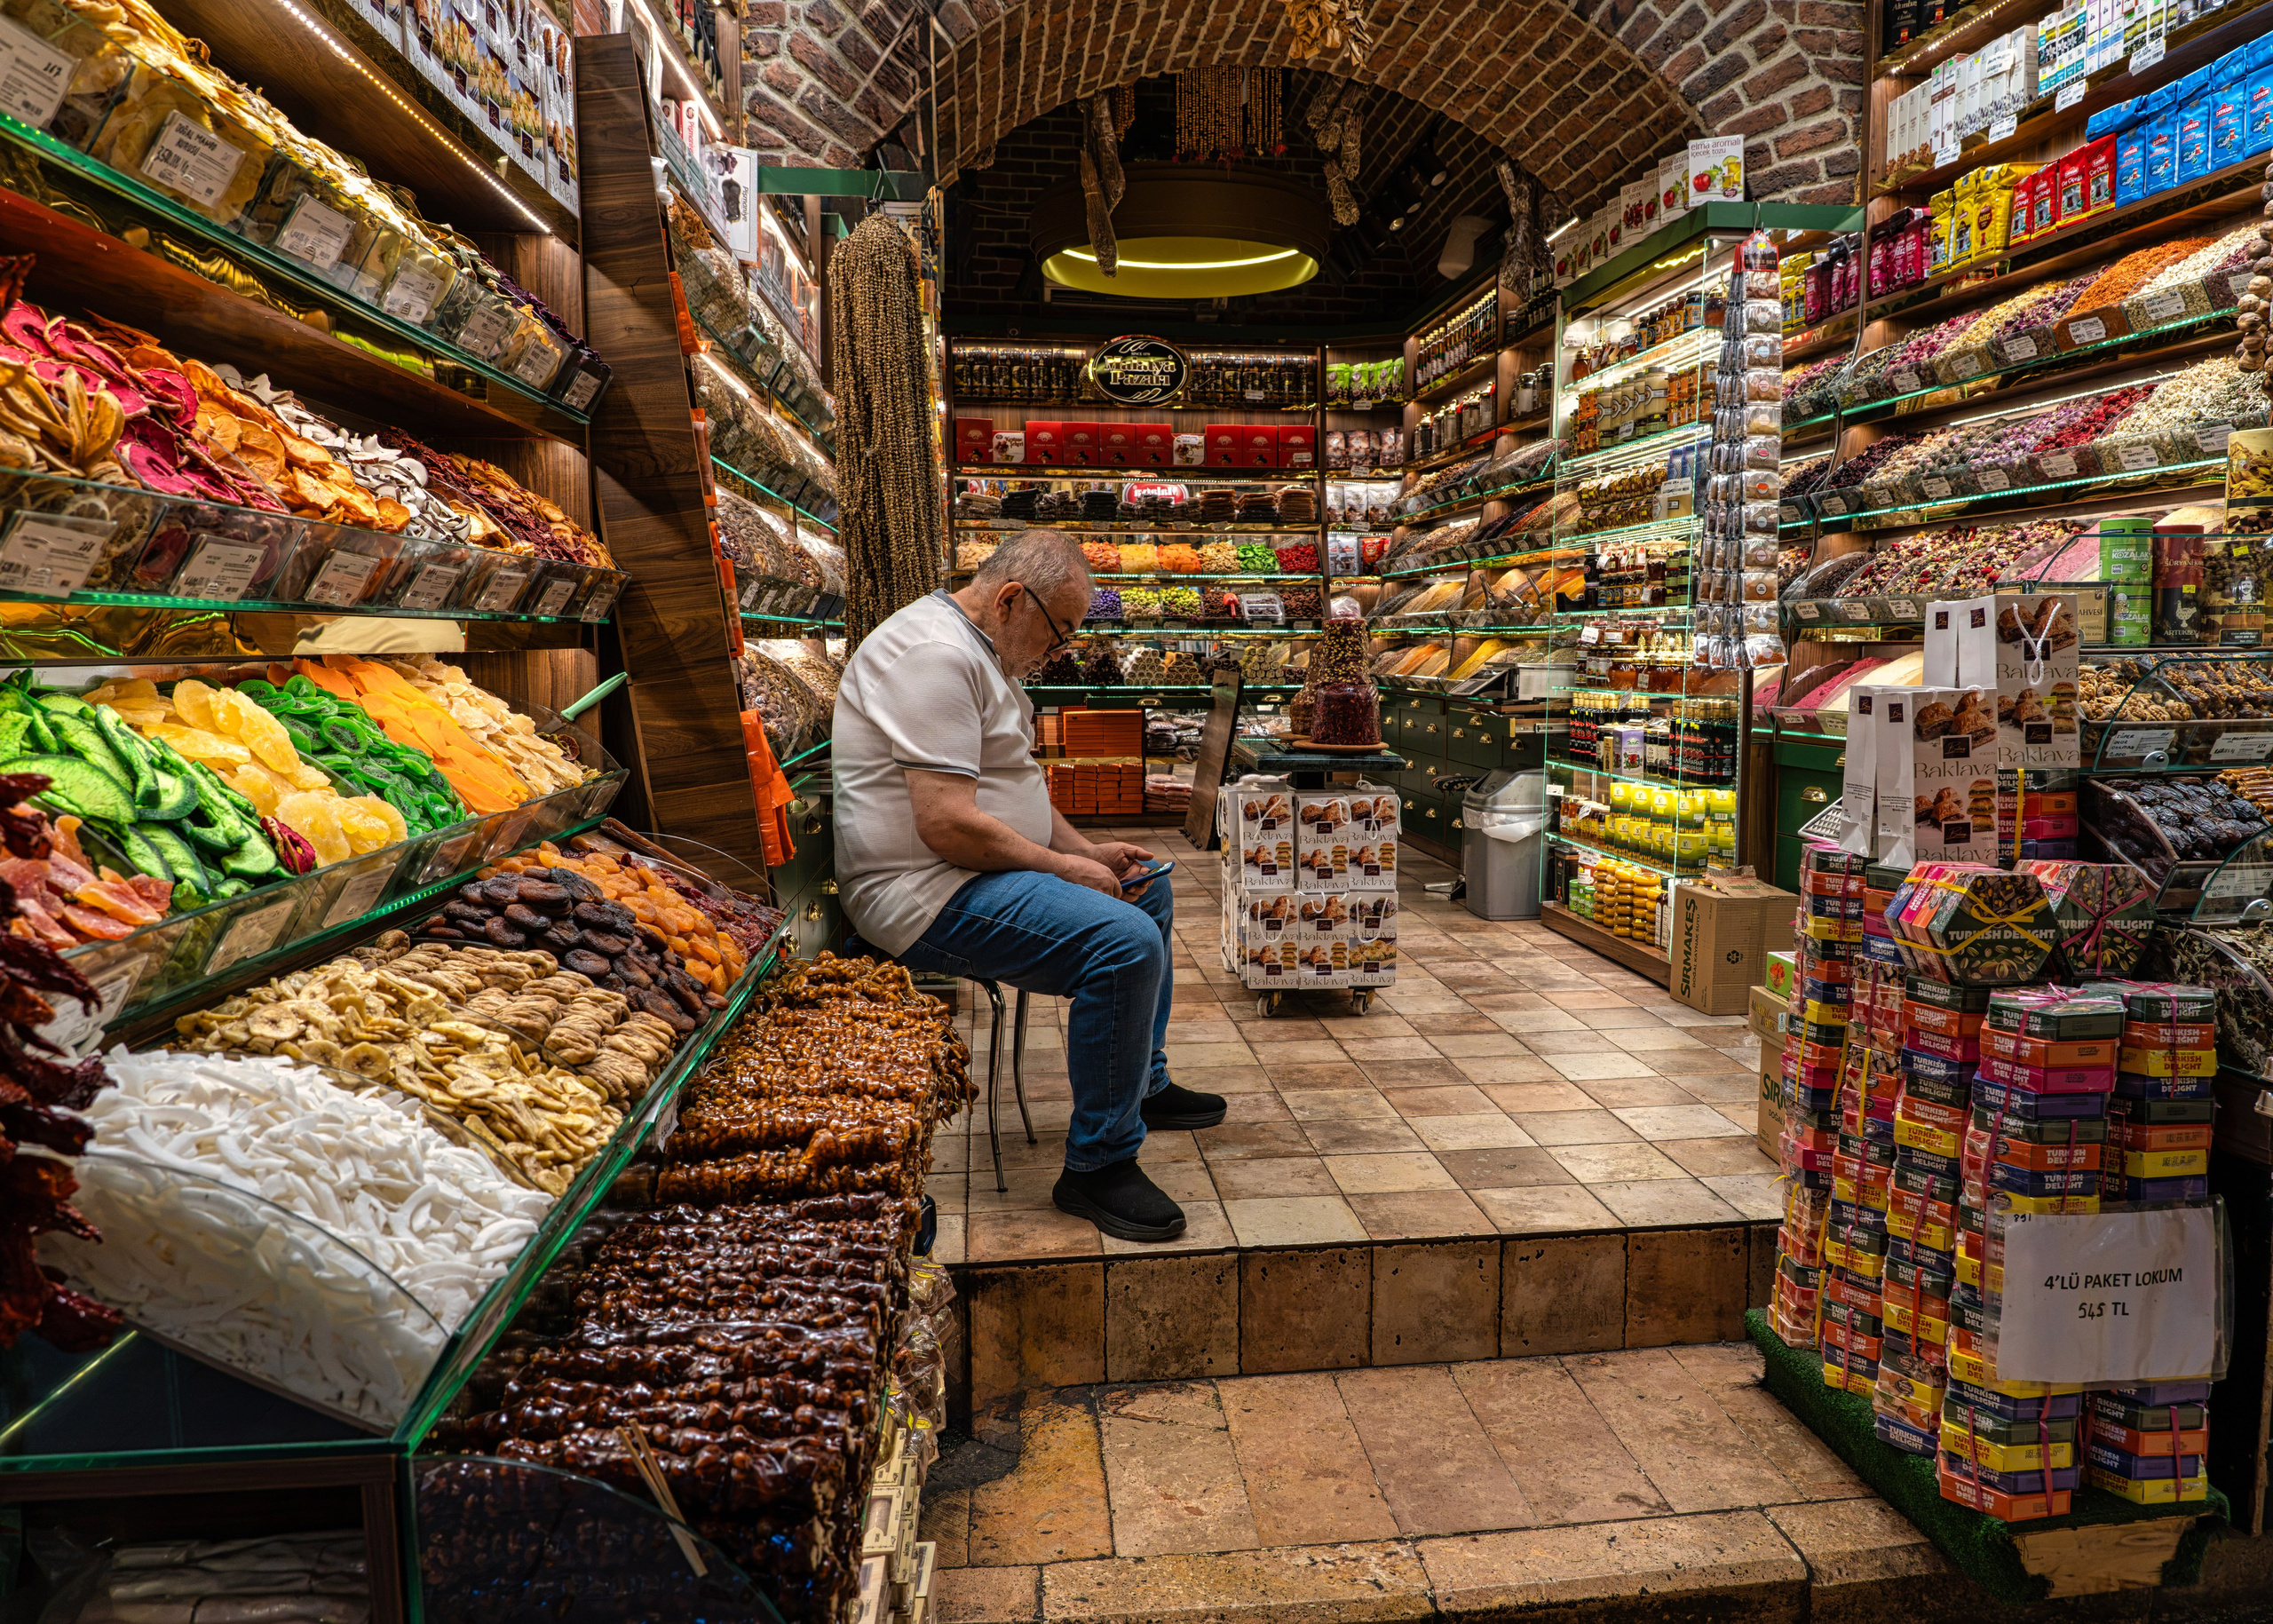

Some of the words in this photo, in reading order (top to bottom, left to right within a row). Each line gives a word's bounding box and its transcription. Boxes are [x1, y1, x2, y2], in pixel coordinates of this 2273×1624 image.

[1691, 142, 1710, 151] elma
[1712, 138, 1741, 147] aromalı
[1691, 149, 1711, 158] içecek
[1104, 355, 1176, 375] Malatya
[1110, 370, 1171, 386] Pazarı
[1997, 662, 2079, 680] Baklava
[1998, 746, 2080, 763] Baklava
[1913, 762, 1998, 779] Baklava
[1299, 835, 1349, 844] Baklava
[1915, 845, 1998, 861] Baklava
[1245, 876, 1295, 886] Baklava
[1300, 880, 1349, 890] Baklava
[1350, 877, 1397, 886] Baklava
[1248, 931, 1299, 941] Baklava
[1299, 931, 1349, 941] Baklava
[1871, 947, 1895, 956] DELIGHT
[1248, 977, 1299, 986] Baklava
[1299, 977, 1349, 986] Baklava
[1350, 974, 1397, 984] Baklava
[1917, 982, 1951, 995] TURKISH
[1918, 989, 1951, 1002] DELIGHT
[1914, 1007, 1947, 1021] TURKISH
[1914, 1014, 1946, 1028] DELIGHT
[1919, 1031, 1952, 1045] TURKISH
[1919, 1038, 1951, 1052] DELIGHT
[1913, 1055, 1946, 1070] TURKISH
[1913, 1062, 1946, 1076] DELIGHT
[1919, 1078, 1952, 1093] TURKISH
[1919, 1085, 1952, 1099] DELIGHT
[1914, 1103, 1949, 1118] TURKISH
[1914, 1110, 1949, 1124] DELIGHT
[1907, 1127, 1943, 1142] TURKISH
[1907, 1133, 1942, 1147] DELIGHT
[1912, 1149, 1948, 1165] TURKISH
[1912, 1156, 1947, 1171] DELIGHT
[1847, 1274, 1876, 1288] DELIGHT
[2044, 1272, 2079, 1290] 4'LÜ
[2085, 1273, 2132, 1288] PAKET
[2135, 1268, 2182, 1287] LOKUM
[2079, 1302, 2106, 1320] 545
[2111, 1302, 2129, 1316] TL
[1962, 1382, 2000, 1403] TURKISH
[1963, 1390, 2000, 1409] DELIGHT
[1889, 1424, 1923, 1443] TURKISH
[1889, 1432, 1923, 1451] DELIGHT
